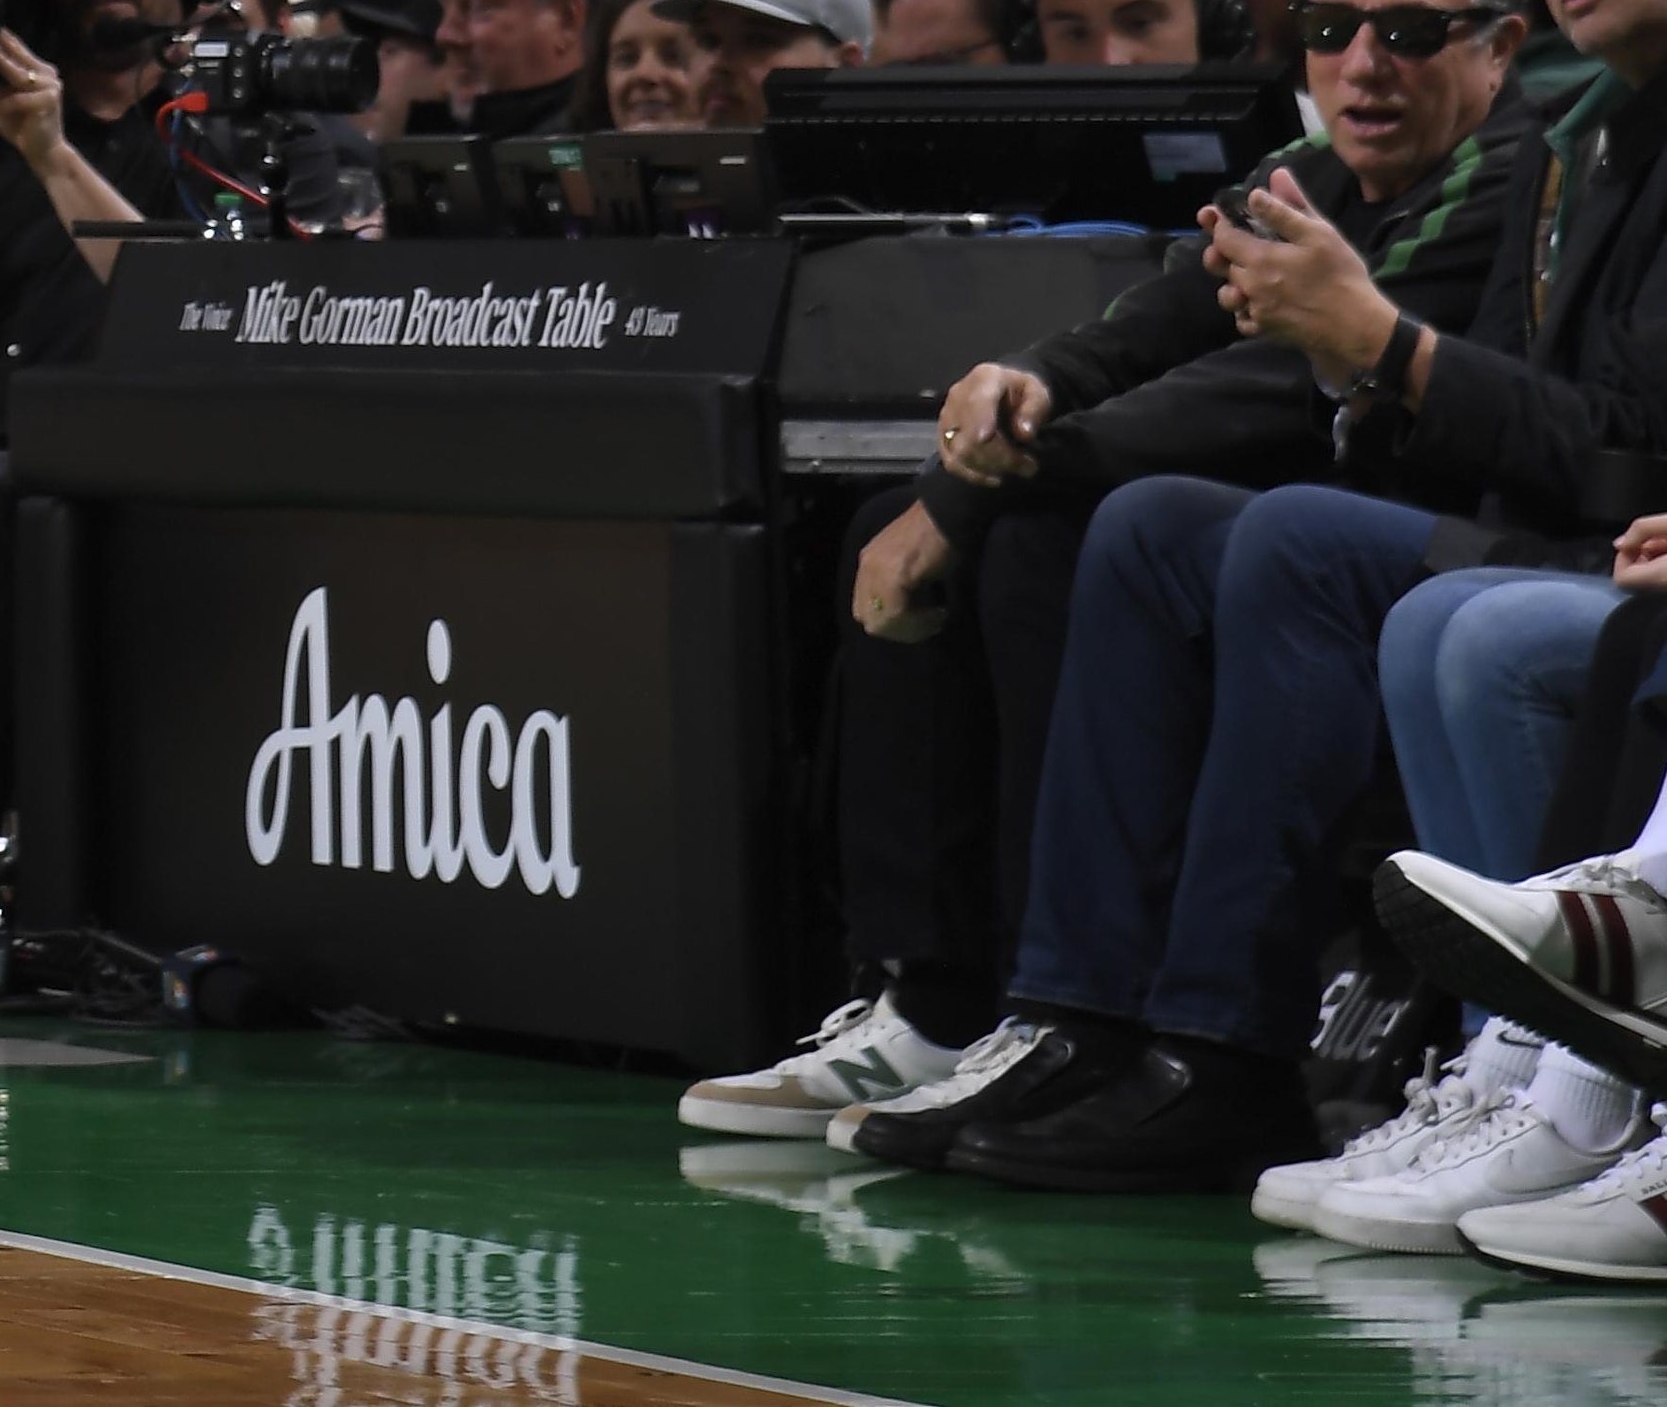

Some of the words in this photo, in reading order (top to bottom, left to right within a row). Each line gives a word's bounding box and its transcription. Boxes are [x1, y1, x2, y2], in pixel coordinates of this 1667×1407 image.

[179, 301, 203, 331] The
[234, 280, 301, 344] Mike
[299, 286, 405, 345] Gorman
[401, 281, 541, 347] Broadcast
[537, 281, 617, 349] Table
[643, 306, 681, 337] Years
[245, 586, 581, 899] Amica
